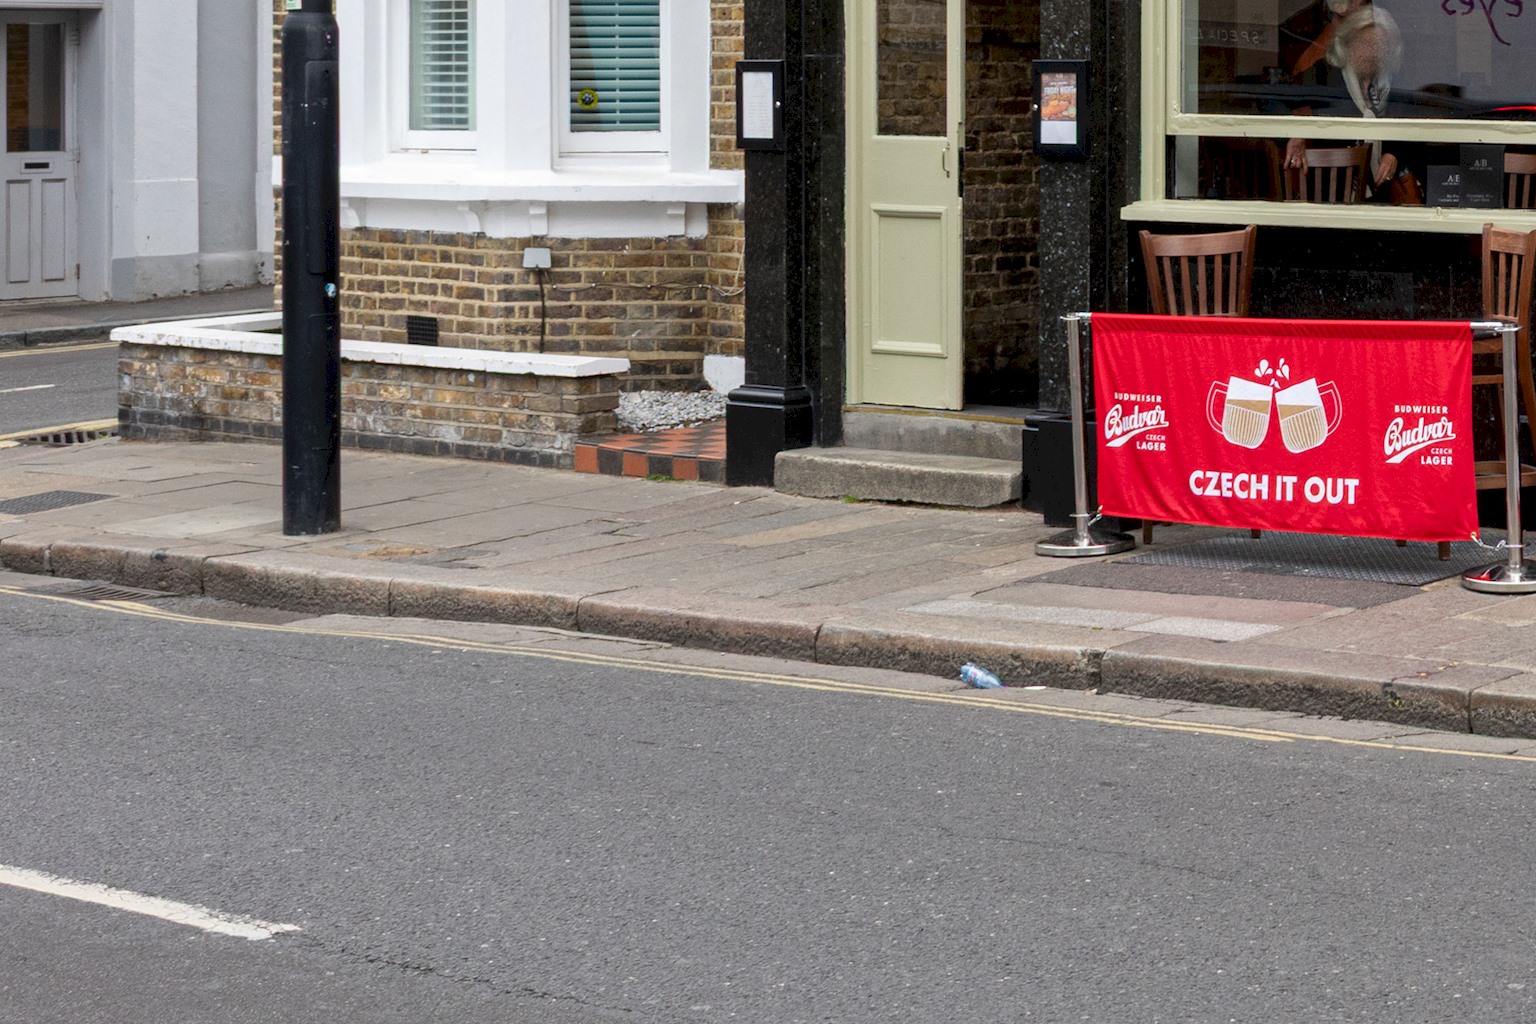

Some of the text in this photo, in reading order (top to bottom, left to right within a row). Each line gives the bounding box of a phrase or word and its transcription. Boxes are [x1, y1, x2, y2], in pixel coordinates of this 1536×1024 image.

[1114, 392, 1162, 403] BUDWEISER
[1394, 404, 1449, 414] BUDWEISER
[1104, 403, 1169, 442] Budvar
[1384, 416, 1457, 458] Budvar
[1136, 441, 1166, 451] LAGER
[1420, 455, 1453, 466] LAGER
[1188, 469, 1360, 505] CZECH IT OUT
